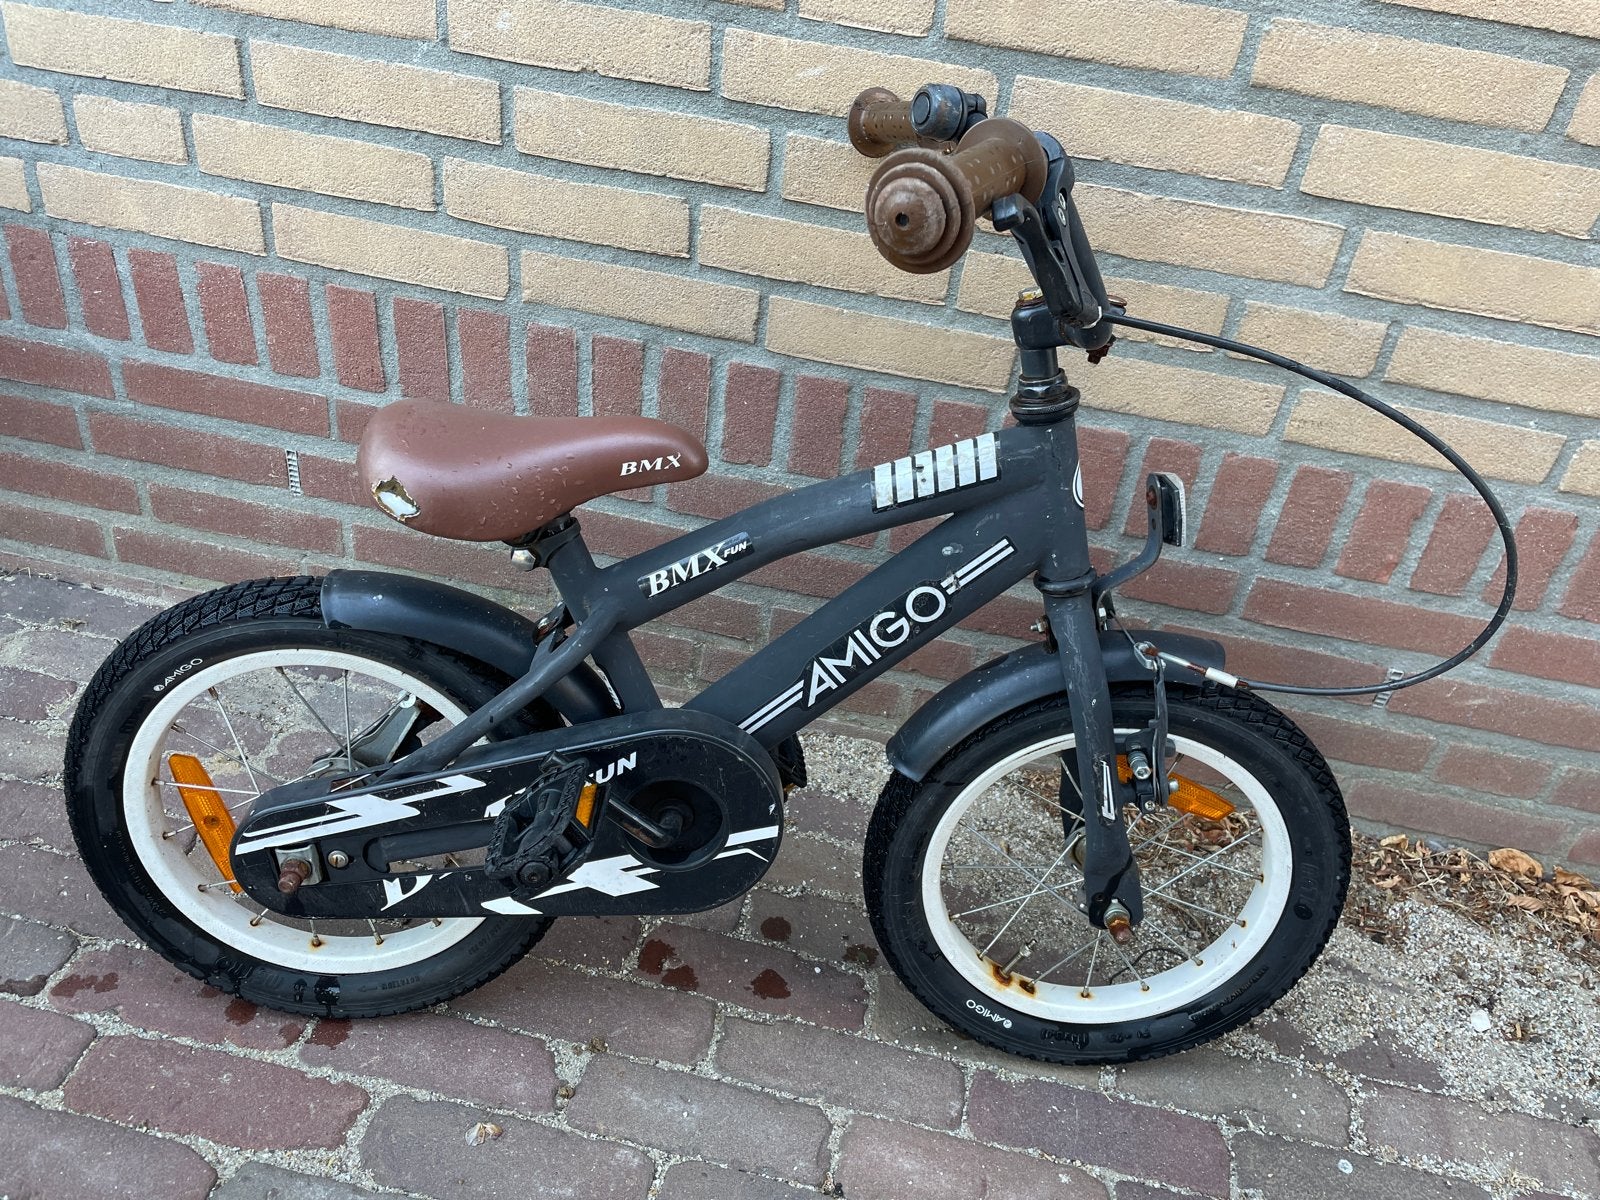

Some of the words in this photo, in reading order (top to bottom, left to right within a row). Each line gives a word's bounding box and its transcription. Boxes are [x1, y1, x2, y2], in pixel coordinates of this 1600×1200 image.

[619, 452, 681, 476] BMX
[647, 541, 728, 598] BMX
[723, 541, 748, 558] FUN
[807, 586, 947, 708] AMIGO
[164, 658, 203, 687] AMIGO
[966, 999, 1006, 1022] AMIGO
